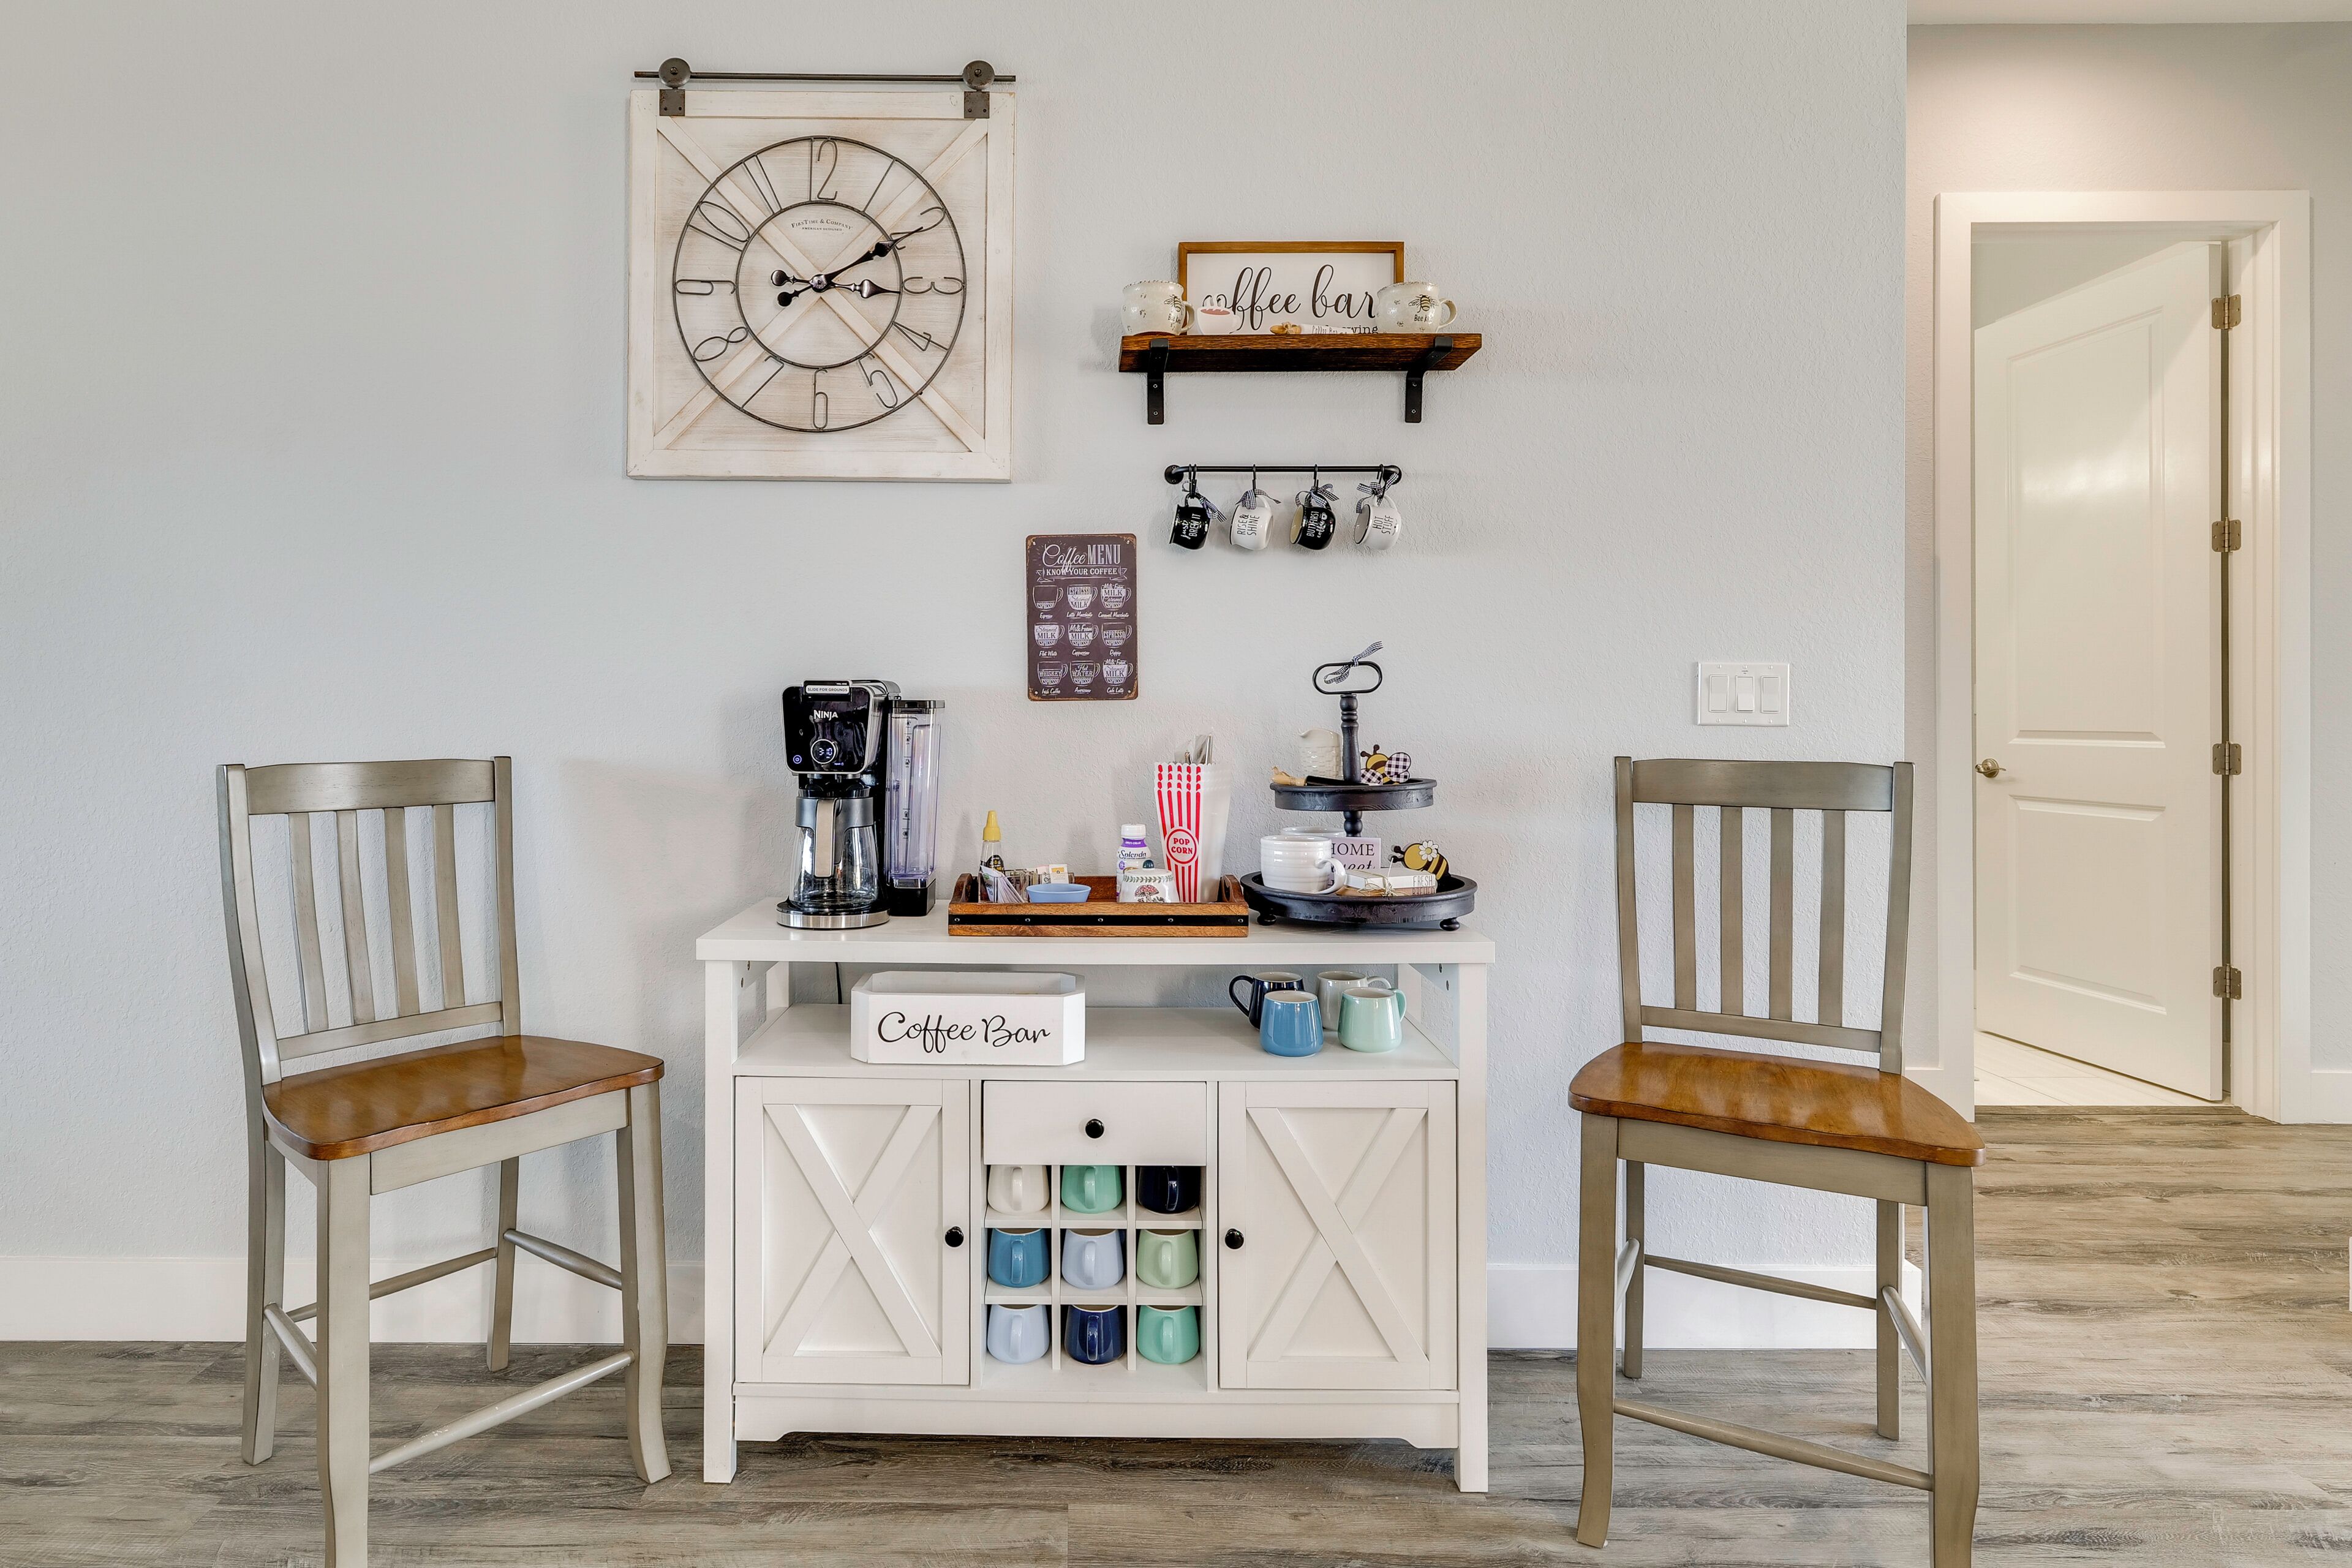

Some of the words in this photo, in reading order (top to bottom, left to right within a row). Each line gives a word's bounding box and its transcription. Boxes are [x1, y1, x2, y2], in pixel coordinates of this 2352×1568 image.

[809, 138, 838, 201] 12
[742, 154, 783, 214] 11
[687, 200, 750, 252] 10
[889, 206, 946, 251] 2
[902, 276, 965, 295] 3
[1312, 264, 1376, 318] bar
[693, 326, 749, 362] 8
[892, 321, 949, 352] 4
[740, 354, 785, 410] 7
[858, 352, 898, 410] 5
[813, 368, 829, 430] 6
[1188, 521, 1199, 537] BREW
[1237, 520, 1248, 535] RISE
[1247, 514, 1260, 536] SHINE
[1310, 511, 1320, 526] FIRST
[1372, 516, 1384, 530] HOT
[1381, 514, 1394, 535] STUFF
[1180, 520, 1191, 539] just
[1042, 544, 1086, 573] Coffee
[1087, 544, 1121, 565] MENU
[1090, 567, 1118, 576] COFFEE
[813, 709, 839, 721] NINJA
[1170, 846, 1193, 854] CORN
[1173, 837, 1190, 846] POP
[1118, 850, 1147, 860] Splenda
[1412, 875, 1433, 887] FRESH
[877, 1011, 977, 1054] Coffee
[981, 1015, 1051, 1047] Bar
